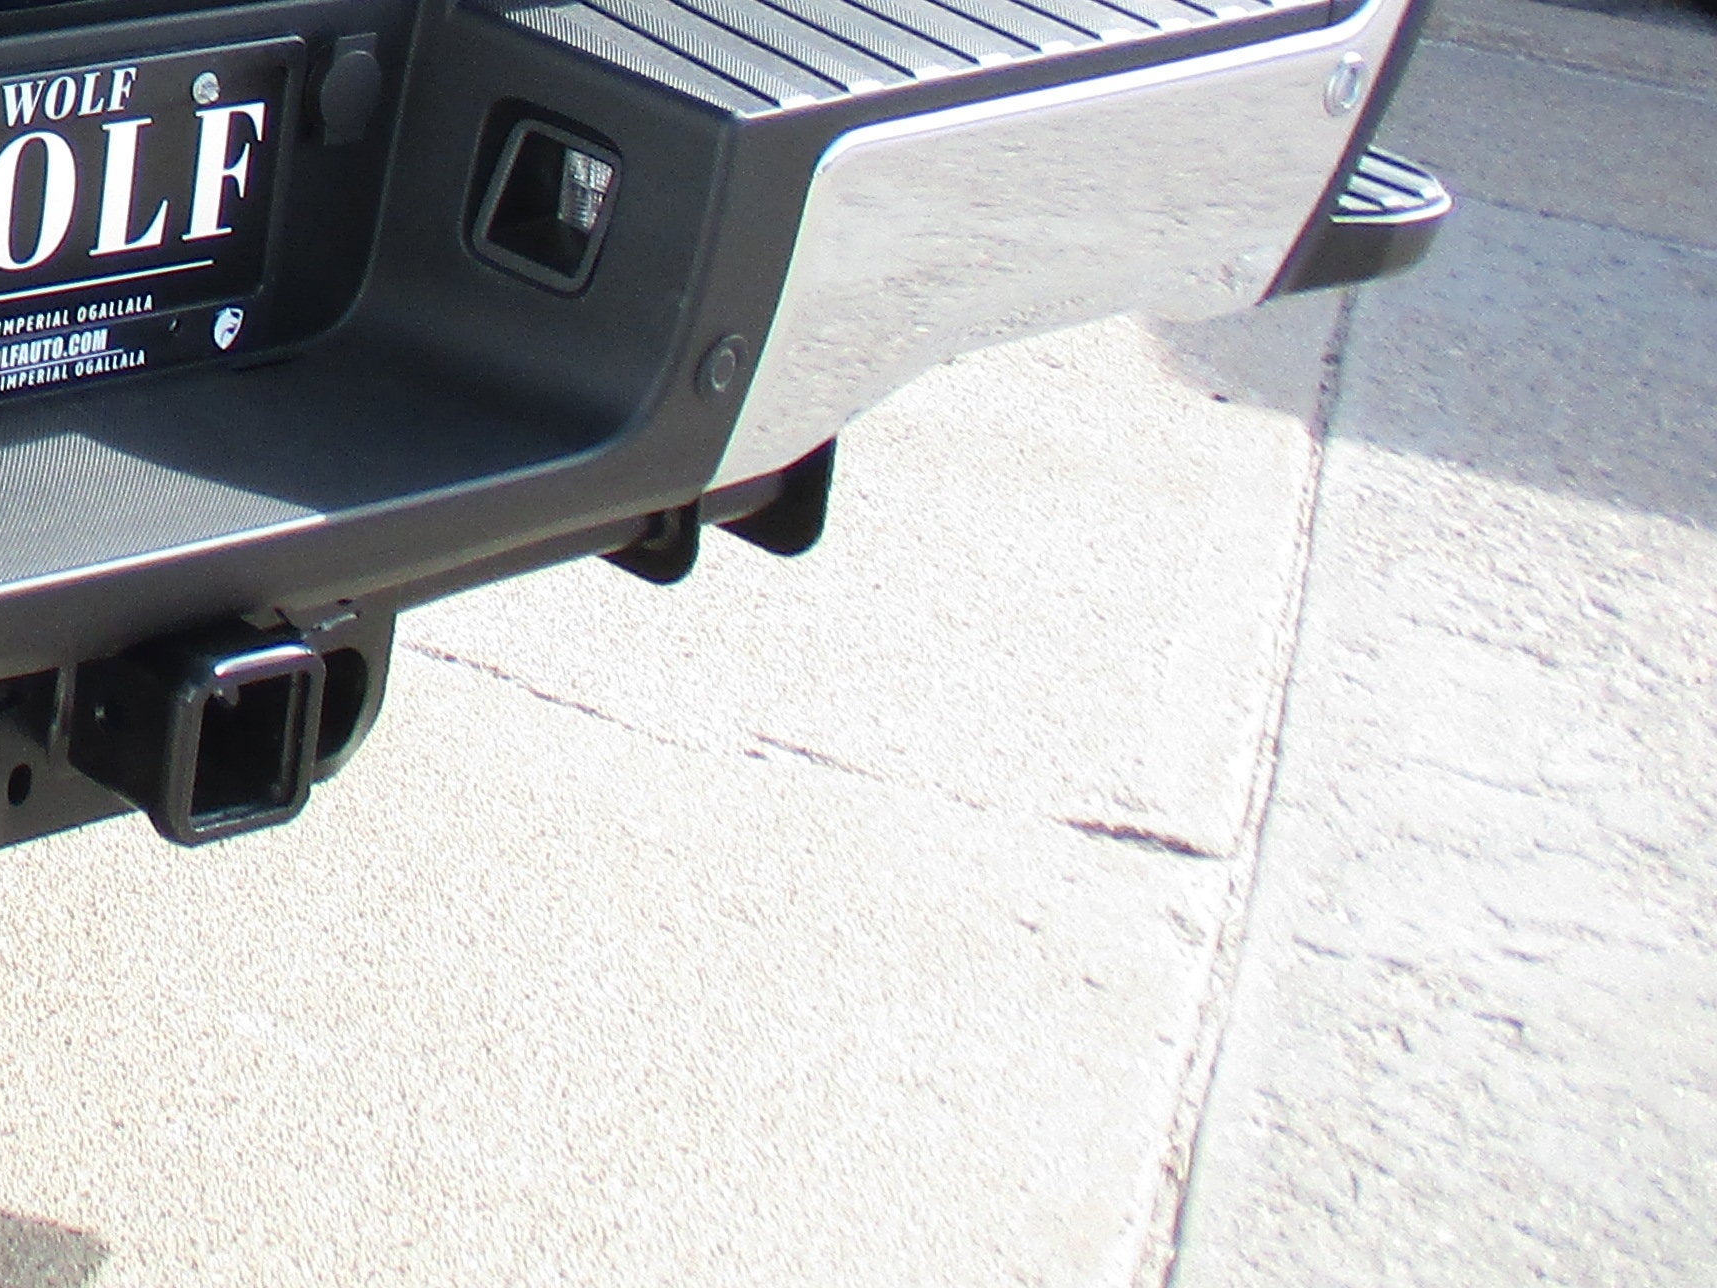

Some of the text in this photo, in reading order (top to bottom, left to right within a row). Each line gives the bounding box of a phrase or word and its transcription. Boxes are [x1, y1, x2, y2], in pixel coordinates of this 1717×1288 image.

[1, 66, 138, 127] WOLF
[77, 294, 153, 322] OGALLALA
[0, 366, 69, 392] IMPERIAL
[75, 349, 146, 377] OGALLALA
